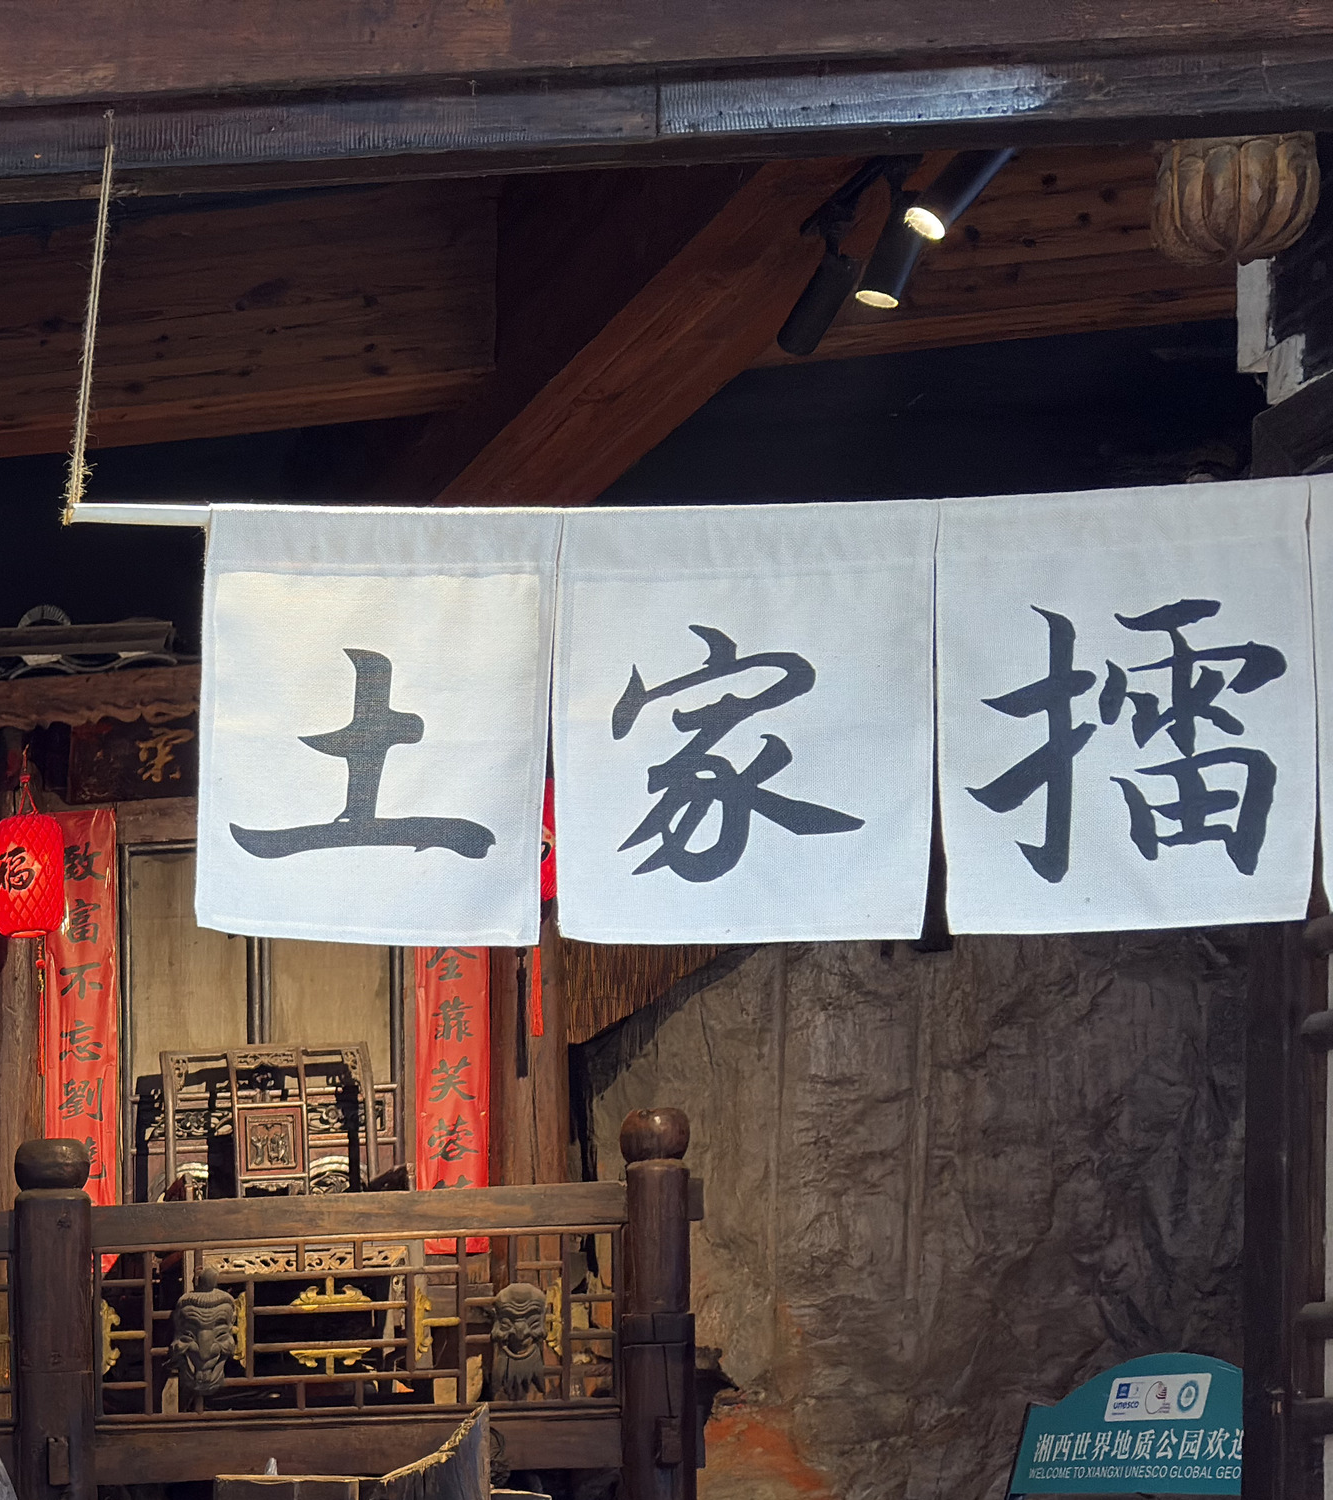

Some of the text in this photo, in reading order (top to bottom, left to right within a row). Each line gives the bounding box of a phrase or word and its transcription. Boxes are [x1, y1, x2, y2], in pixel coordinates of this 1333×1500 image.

[229, 598, 1286, 883] 土家擂
[1029, 1466, 1073, 1479] WELCOME
[1073, 1466, 1085, 1479] TO
[1084, 1465, 1124, 1479] XIANGXI
[1124, 1465, 1168, 1479] UNESCO
[1169, 1465, 1213, 1479] GLOBAL
